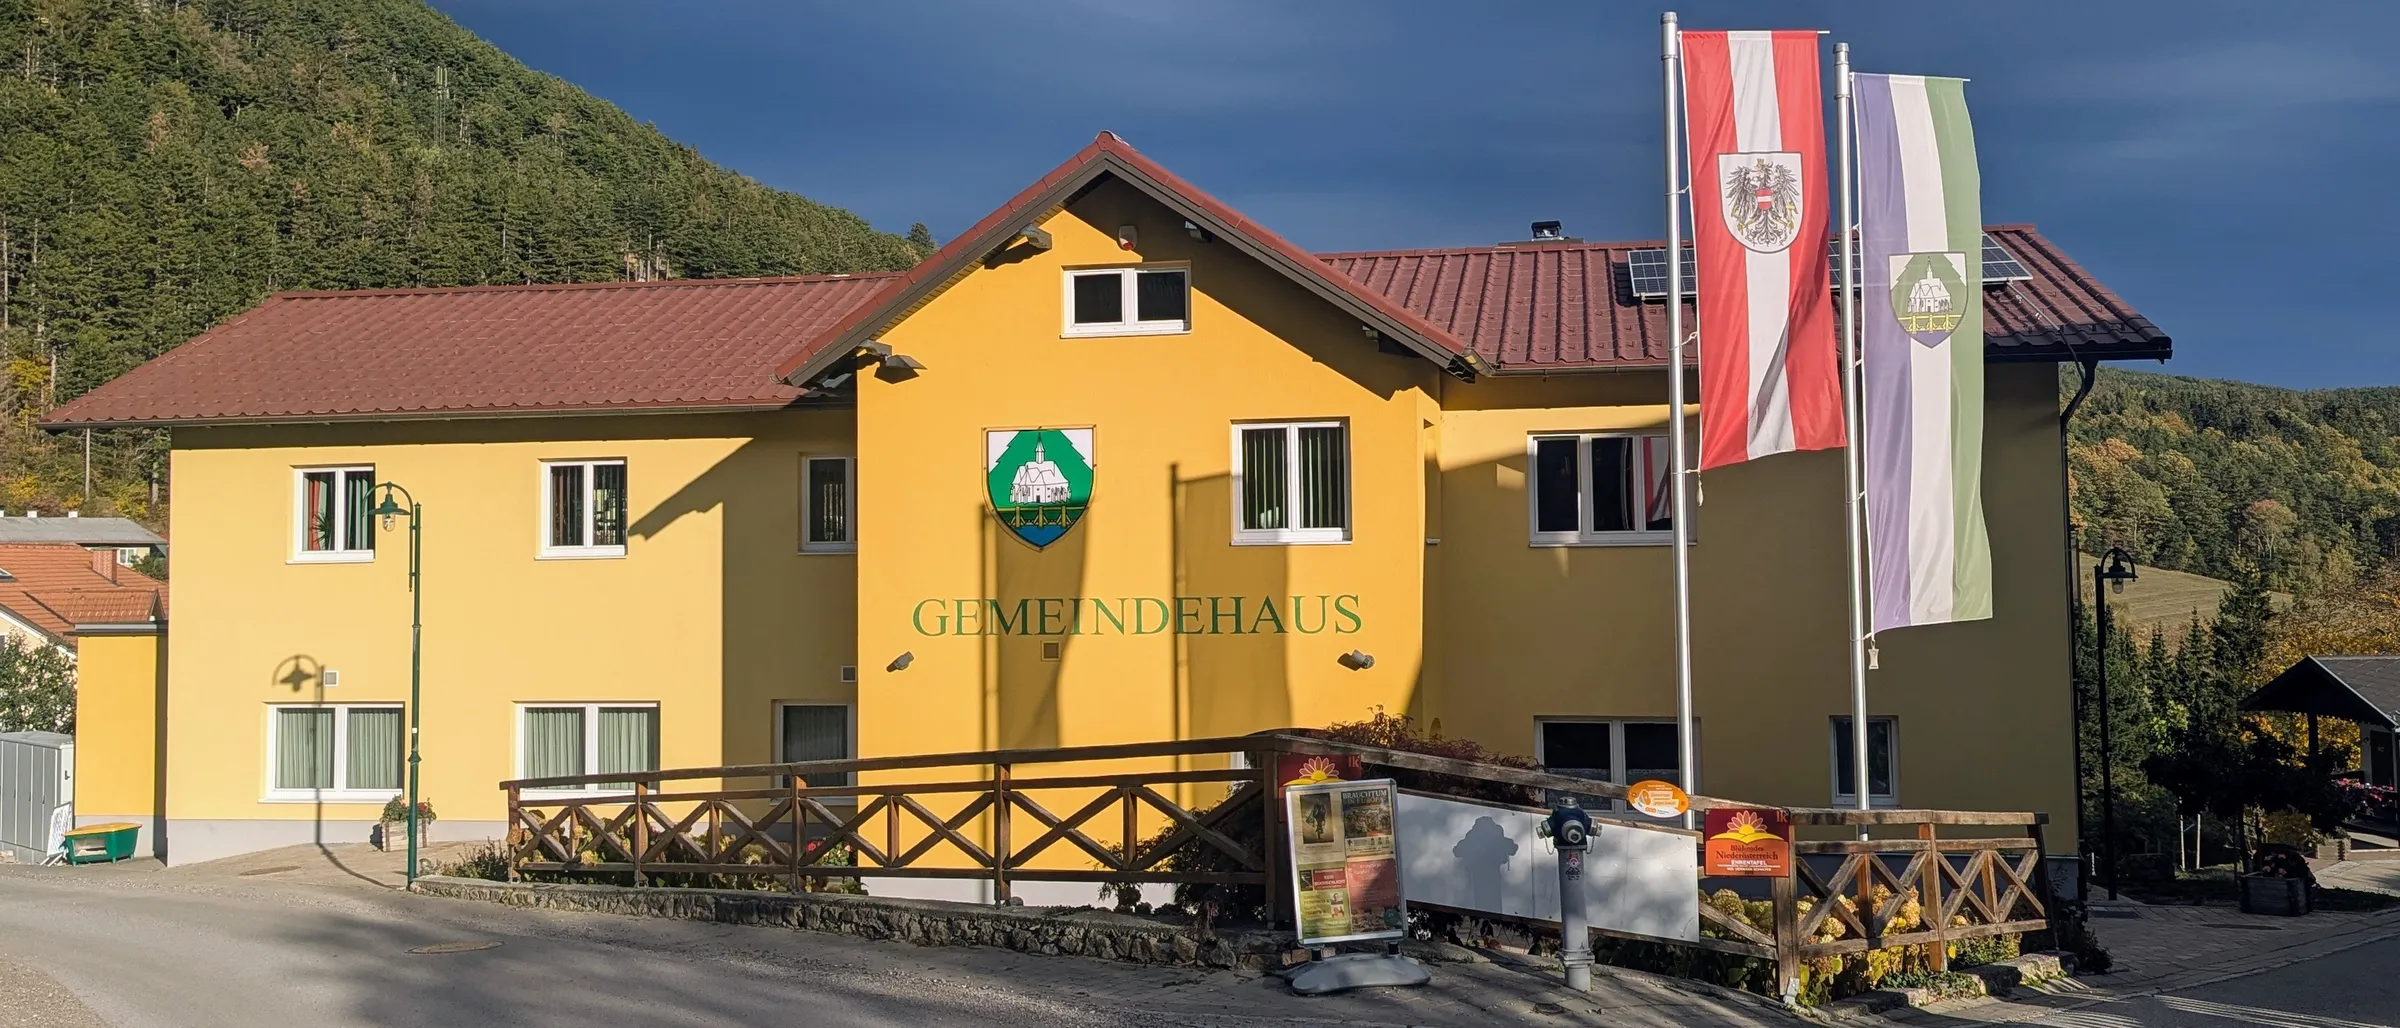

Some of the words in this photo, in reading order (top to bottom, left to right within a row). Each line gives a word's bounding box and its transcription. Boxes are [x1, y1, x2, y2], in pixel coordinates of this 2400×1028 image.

[913, 594, 1362, 637] GEMEINDEHAUS
[1342, 789, 1387, 800] BRAUCHTUM
[1730, 844, 1764, 852] Blühendes
[1715, 850, 1779, 860] Niederösterreich
